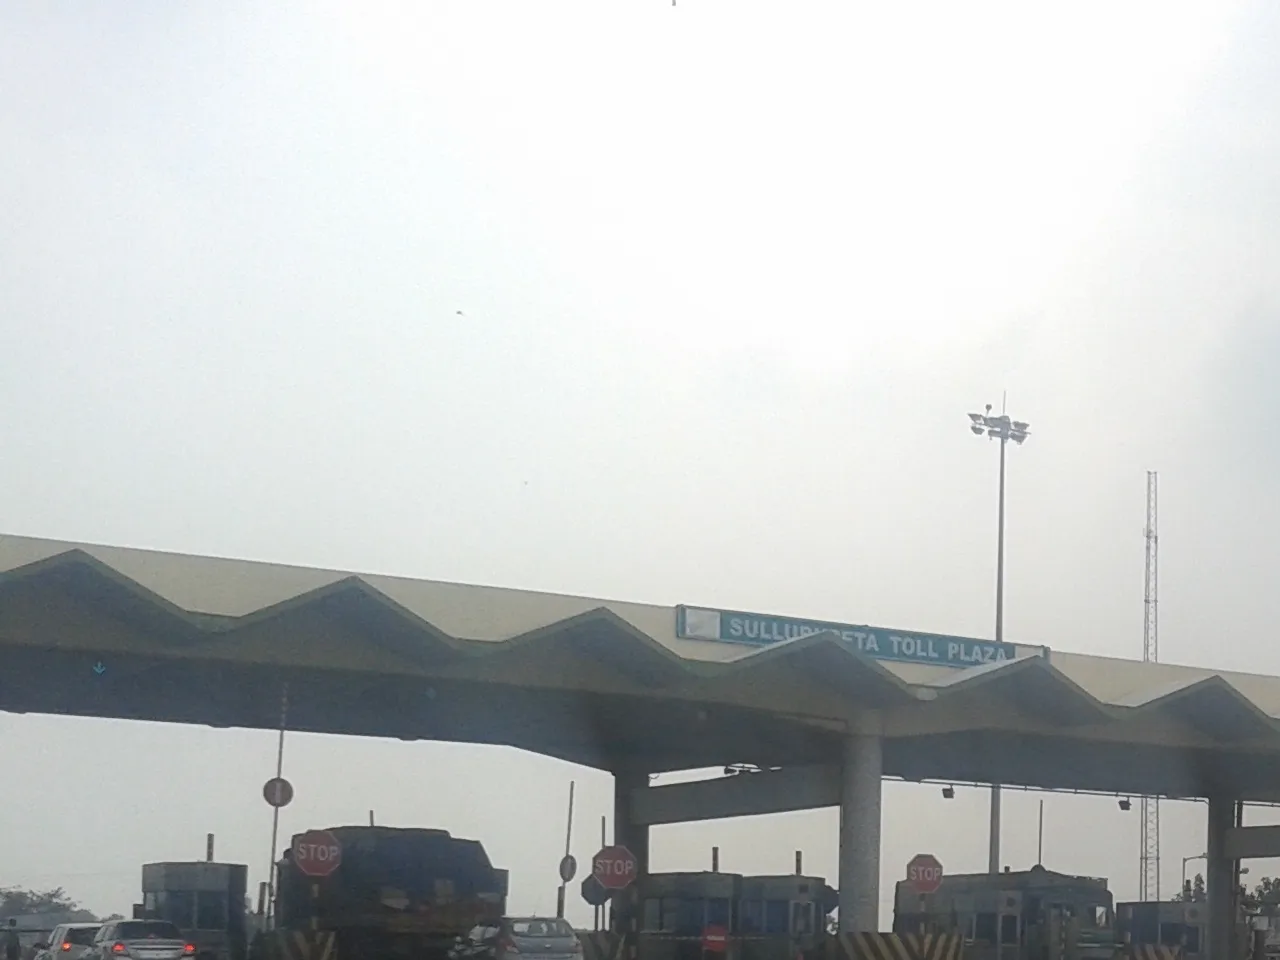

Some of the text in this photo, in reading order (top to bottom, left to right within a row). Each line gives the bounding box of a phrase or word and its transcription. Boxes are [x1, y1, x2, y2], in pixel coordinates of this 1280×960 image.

[890, 636, 939, 658] TOLL
[947, 641, 1007, 663] PLAZA
[298, 843, 339, 861] STOP
[595, 859, 634, 875] STOP
[910, 866, 941, 881] STOP
